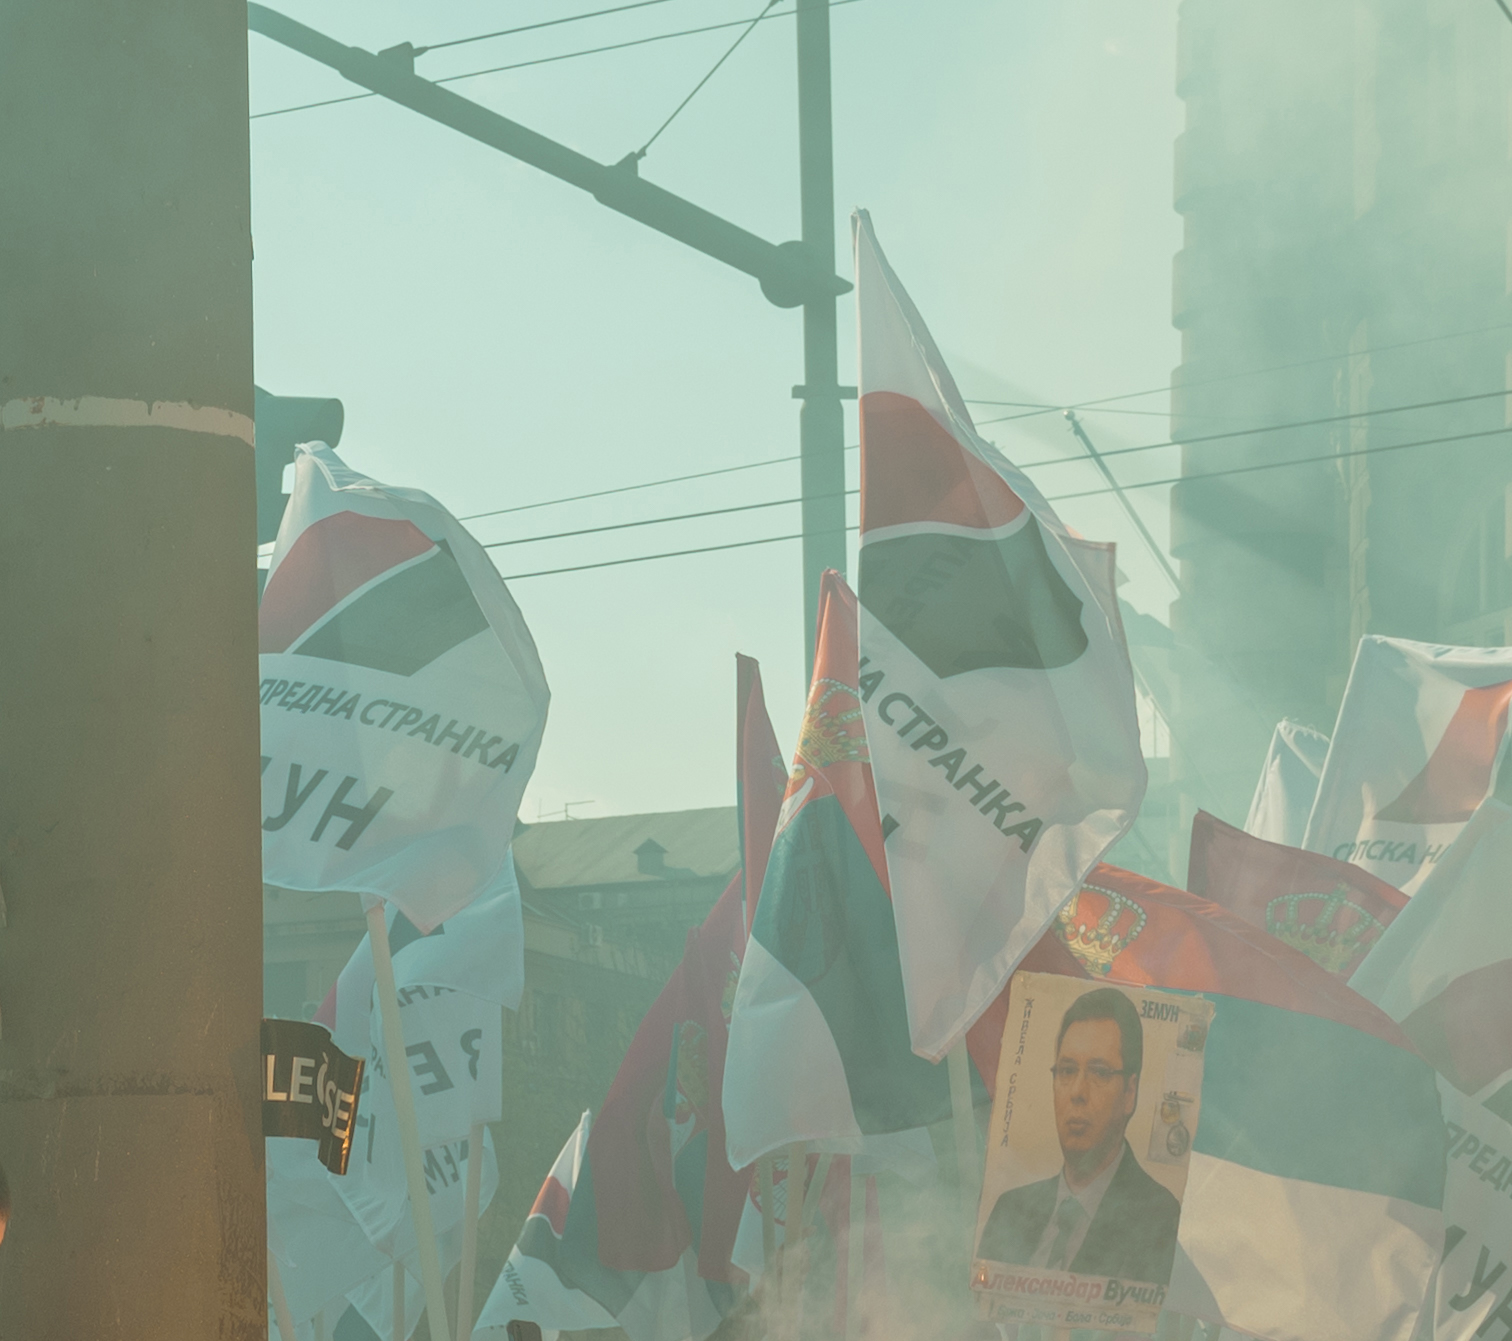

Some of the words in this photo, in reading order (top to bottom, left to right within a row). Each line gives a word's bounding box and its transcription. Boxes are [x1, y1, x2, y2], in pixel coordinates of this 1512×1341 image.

[358, 698, 520, 774] СТРАНКА
[877, 691, 1045, 853] СТРАНКА
[261, 755, 395, 852] УН
[1140, 999, 1180, 1023] ЗЕМУН
[971, 1268, 1102, 1302] Александар
[1103, 1279, 1166, 1307] Вучић
